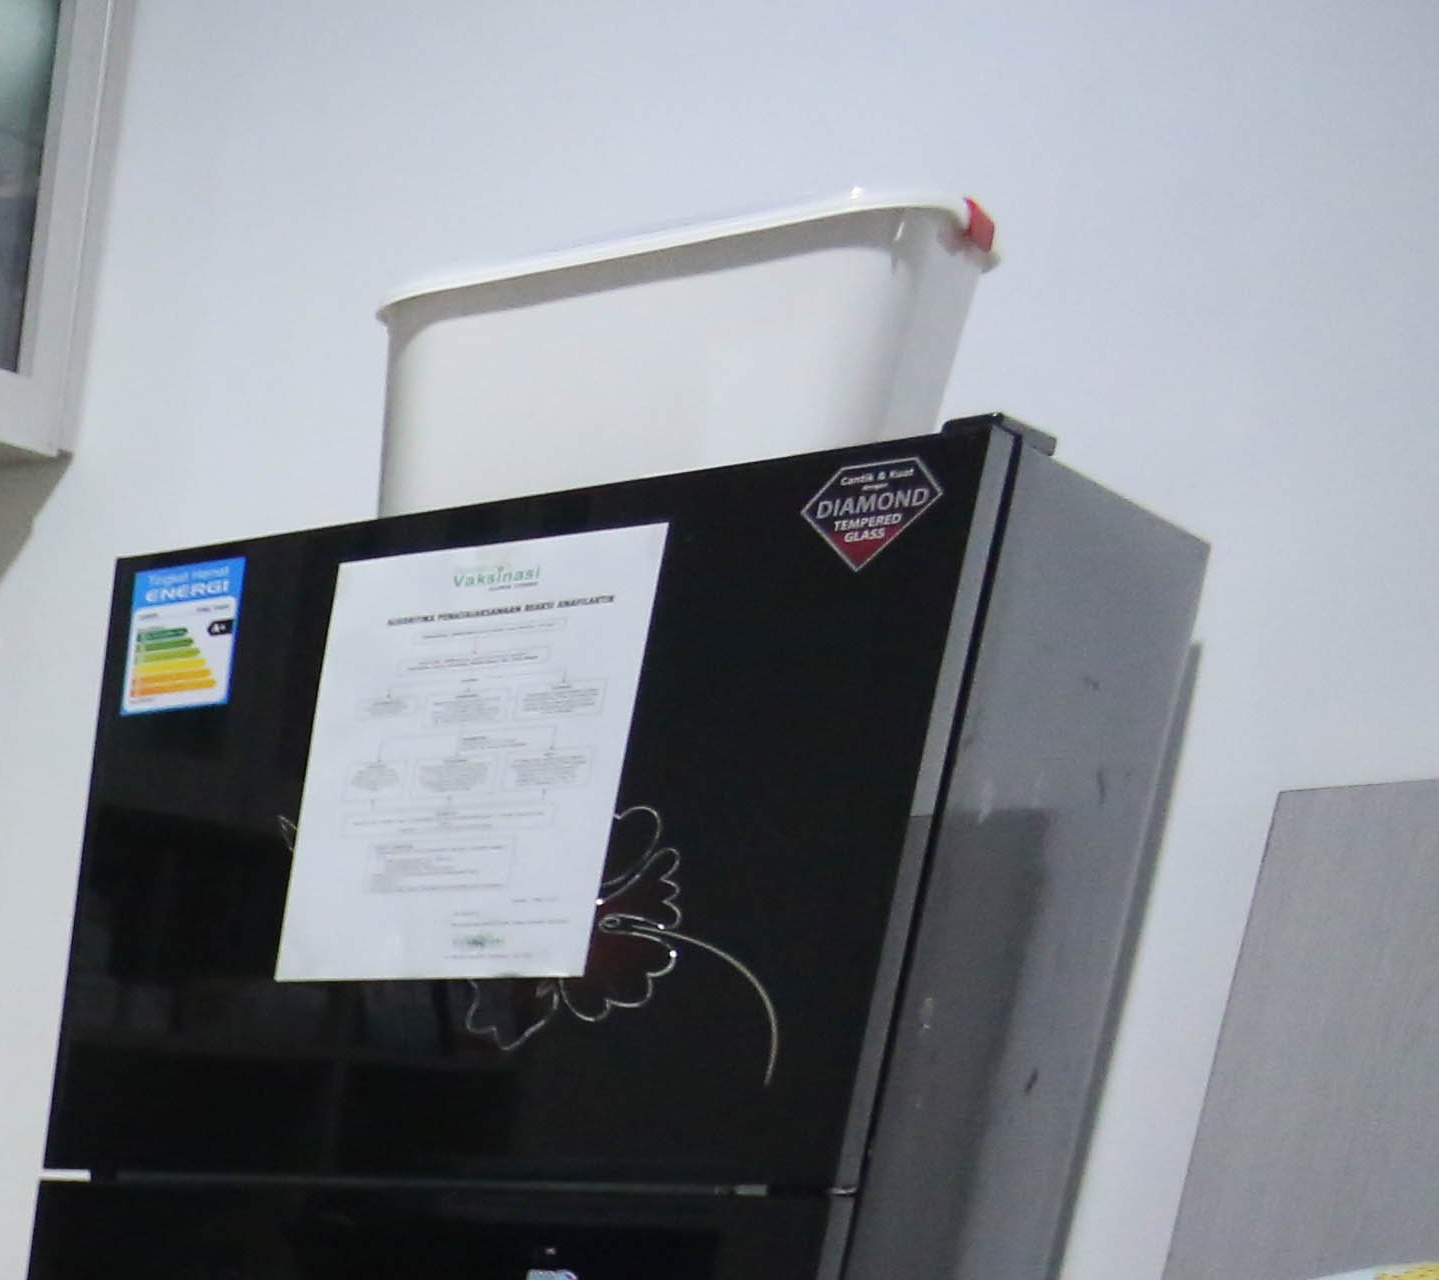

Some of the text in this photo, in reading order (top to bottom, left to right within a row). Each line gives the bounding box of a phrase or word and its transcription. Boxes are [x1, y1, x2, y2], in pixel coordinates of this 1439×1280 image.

[840, 468, 915, 486] Cantik & Kuat
[816, 487, 930, 520] DIAMOND
[833, 513, 903, 532] TEMPERED
[843, 528, 886, 543] GLASS
[453, 564, 541, 588] Vaksinasi
[145, 580, 231, 603] ENERGI
